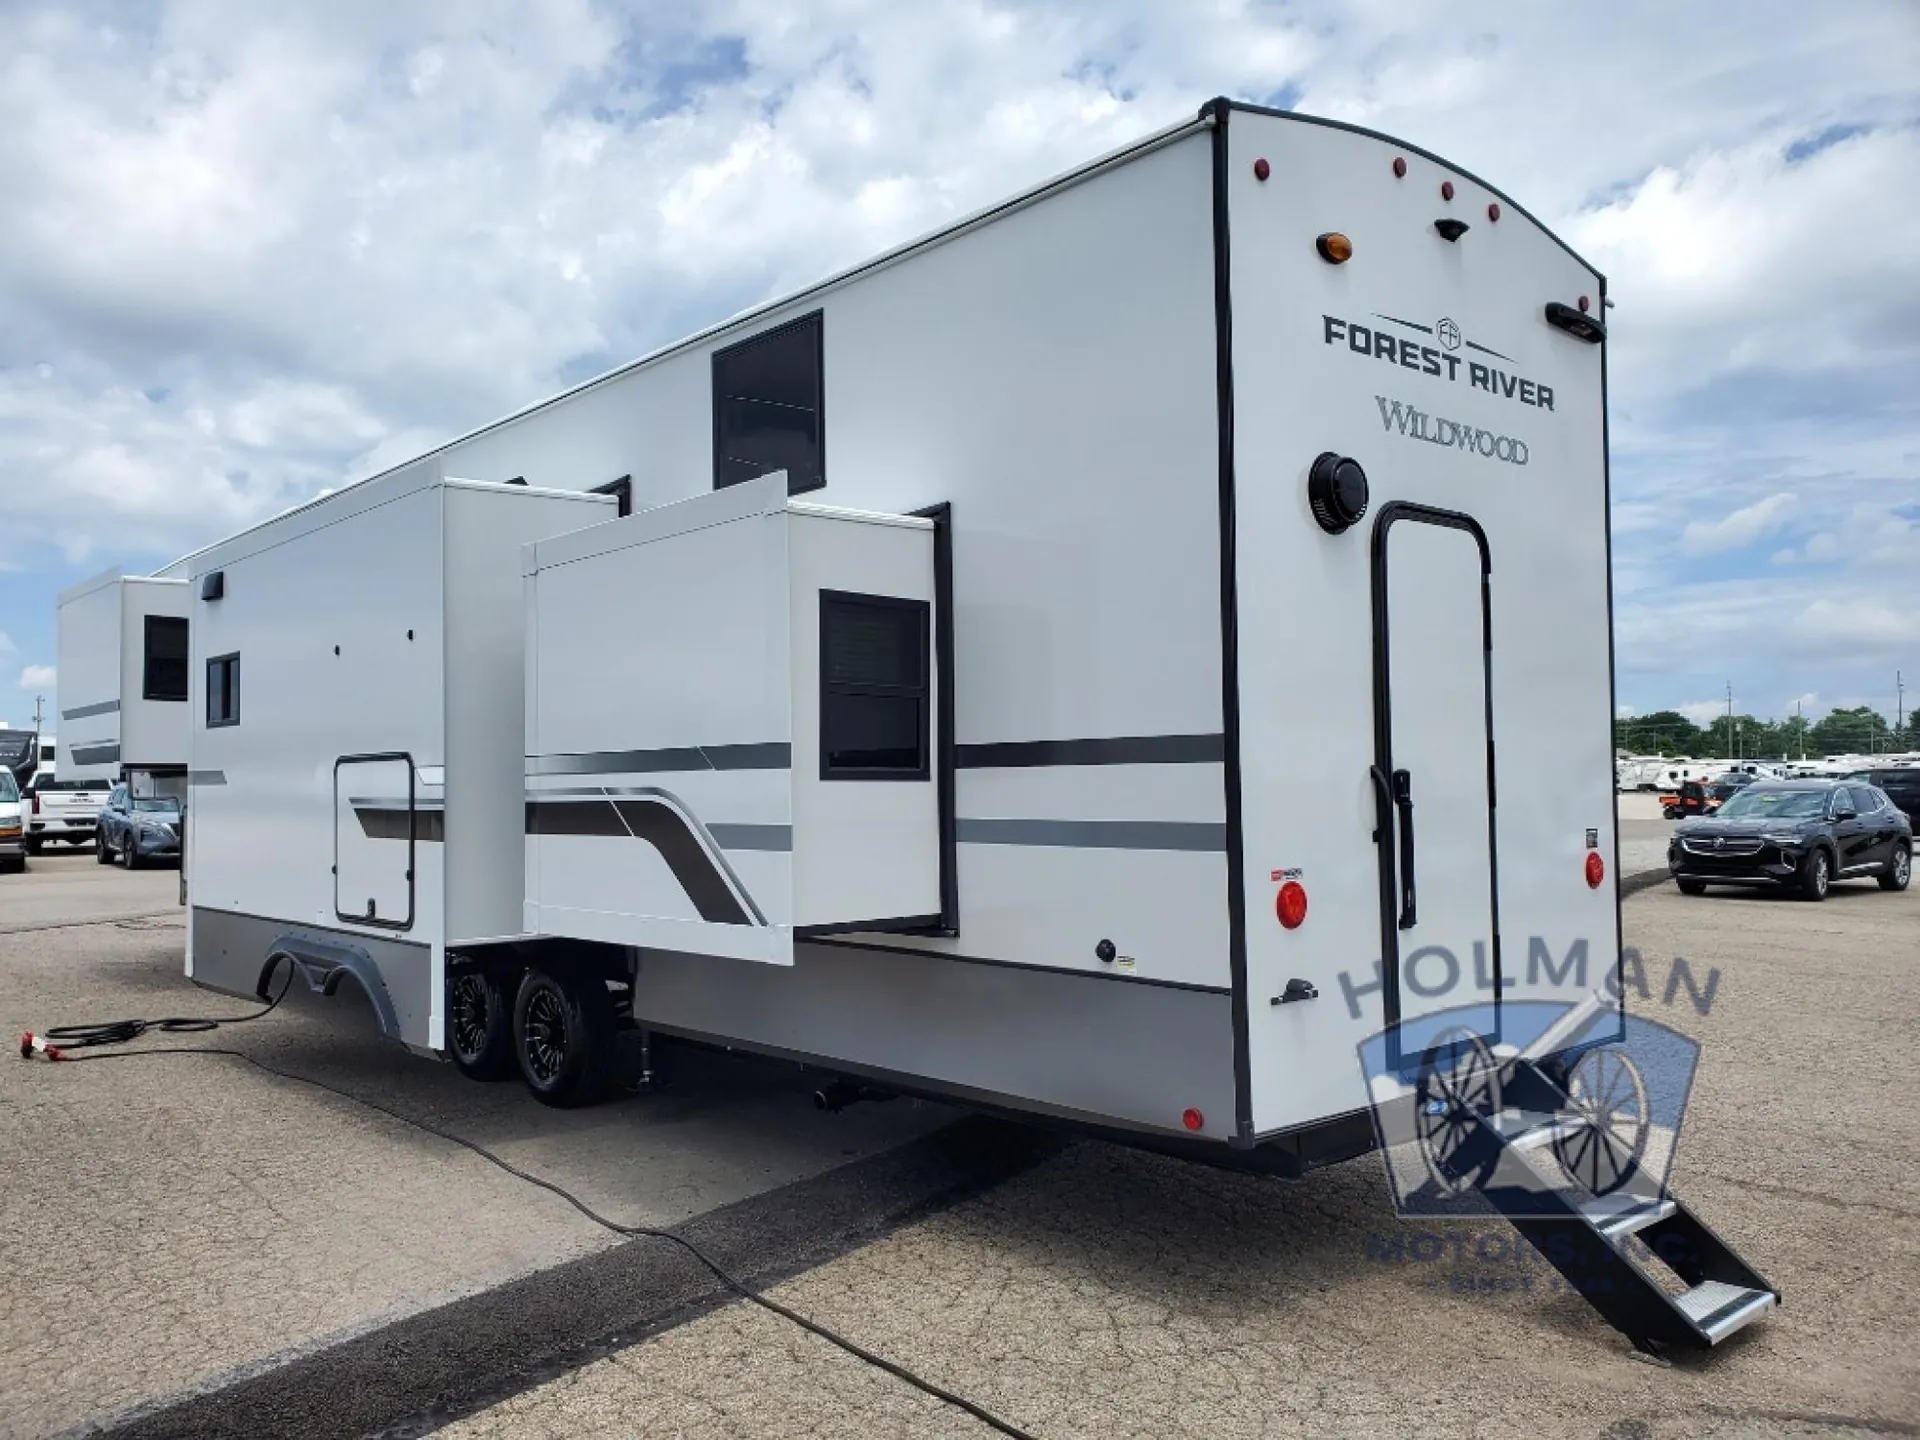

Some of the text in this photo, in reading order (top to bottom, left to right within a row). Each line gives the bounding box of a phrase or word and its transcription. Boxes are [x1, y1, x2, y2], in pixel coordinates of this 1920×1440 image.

[1321, 314, 1555, 412] FOREST RIVER
[1374, 395, 1529, 465] WILDWOOD
